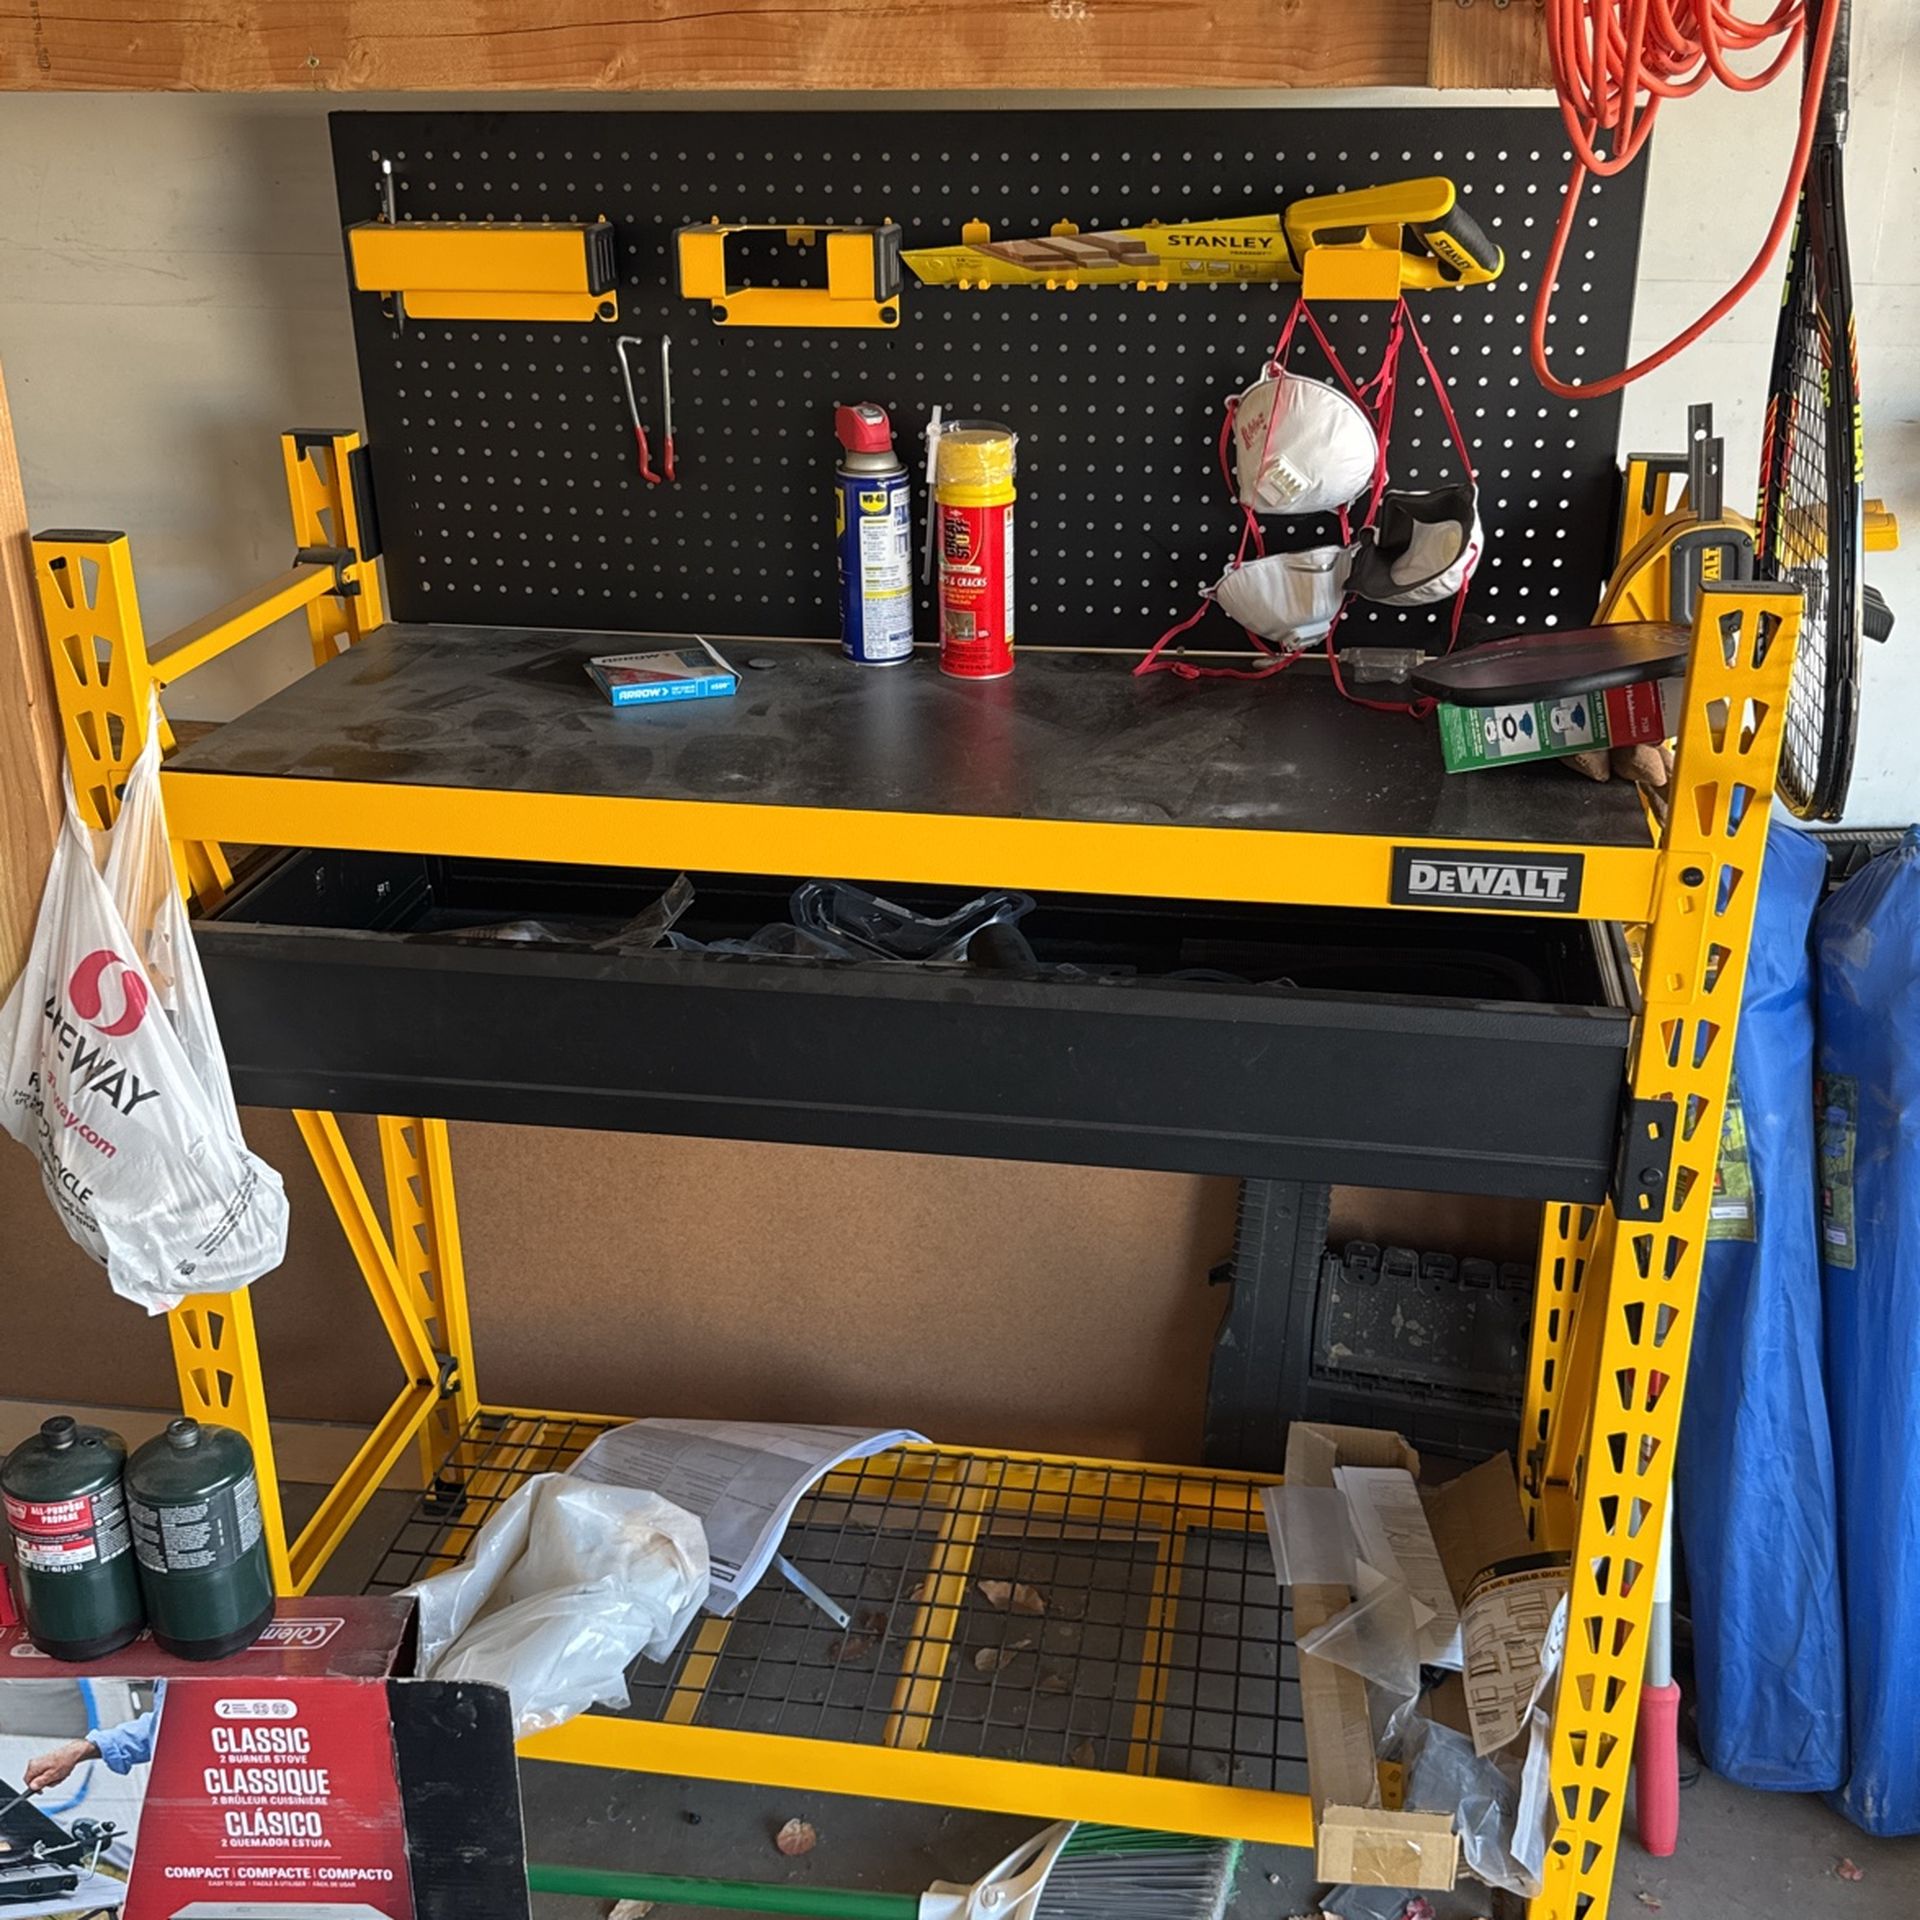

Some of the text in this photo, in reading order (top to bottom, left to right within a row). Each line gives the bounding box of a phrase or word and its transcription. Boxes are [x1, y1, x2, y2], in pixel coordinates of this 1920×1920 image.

[1168, 234, 1273, 248] STANLEY
[1435, 239, 1474, 270] STANLEY
[862, 493, 886, 504] WD-40
[956, 518, 972, 560] STUFF
[1703, 547, 1720, 580] ALT
[618, 687, 662, 701] ARROW
[1408, 863, 1568, 898] DEWALT
[30, 1500, 86, 1516] ALL-PURPOSE
[41, 1511, 80, 1525] PROPANE
[258, 1625, 328, 1646] Colem
[222, 1703, 231, 1714] 2
[211, 1727, 310, 1754] CLASSIC
[219, 1754, 308, 1764] 2 BURNER STOVE
[203, 1768, 331, 1796] CLASSIQUE
[211, 1796, 218, 1805] 2
[224, 1807, 323, 1837] CLÁSICO
[221, 1838, 332, 1848] 2 QUEMADOR ESTUFA
[164, 1866, 394, 1881] COMPACT COMPACTE COMPACTO
